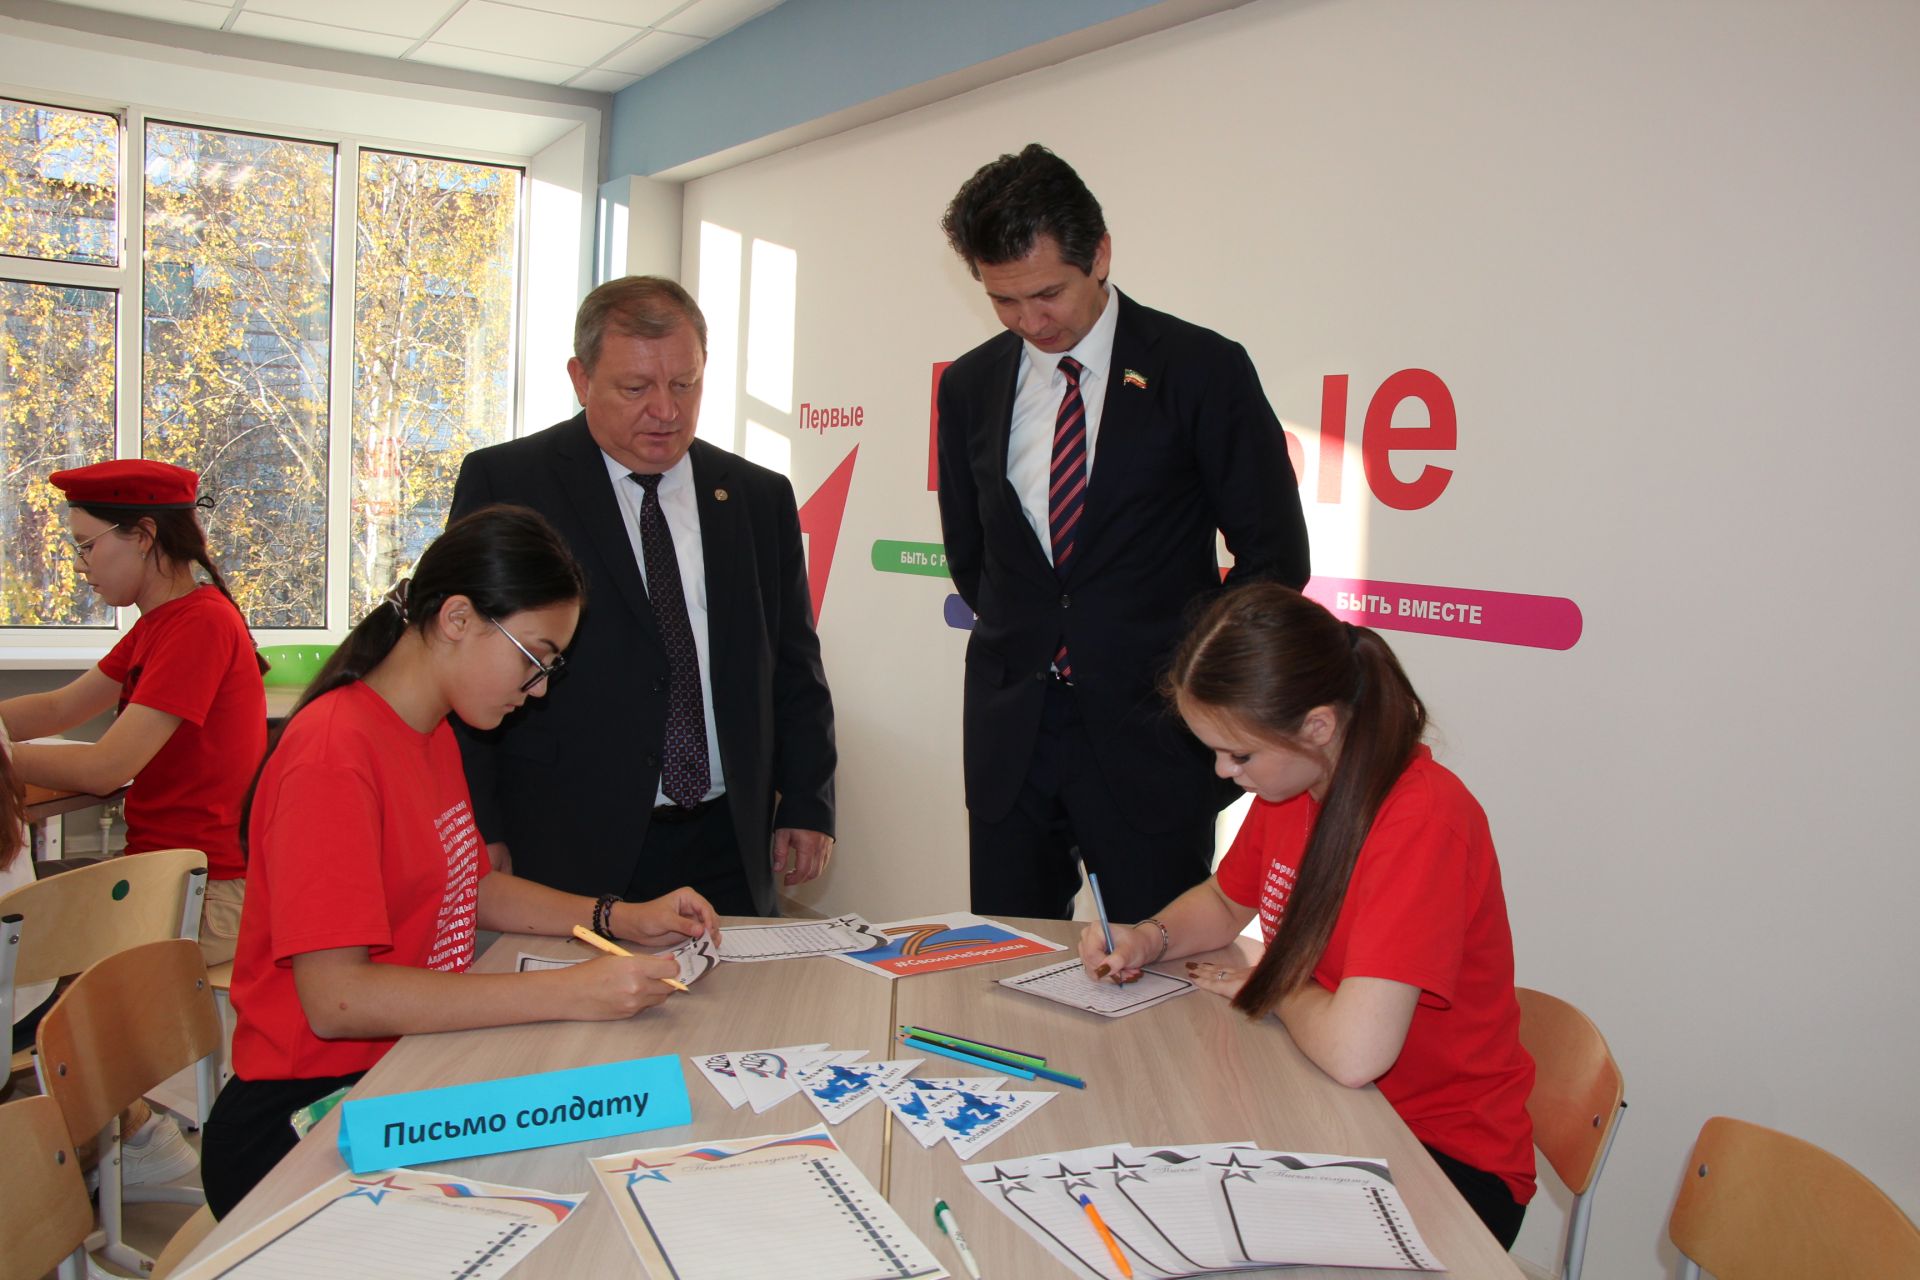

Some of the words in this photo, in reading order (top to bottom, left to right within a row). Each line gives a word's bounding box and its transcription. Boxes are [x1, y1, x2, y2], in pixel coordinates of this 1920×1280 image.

[799, 402, 864, 435] Первые
[900, 551, 928, 566] БЫТЬ
[930, 553, 937, 566] С
[1335, 591, 1392, 615] БЫТЬ
[1398, 598, 1482, 625] ВМЕСТЕ
[894, 943, 1028, 968] #СвоихНеБросаем
[835, 1085, 873, 1110] РОССИЙСКОМ
[383, 1112, 507, 1149] Письмо
[516, 1092, 649, 1129] солдату
[966, 1115, 1007, 1143] РОССИЙСКОМУ
[1007, 1100, 1032, 1119] СОЛДАТУ
